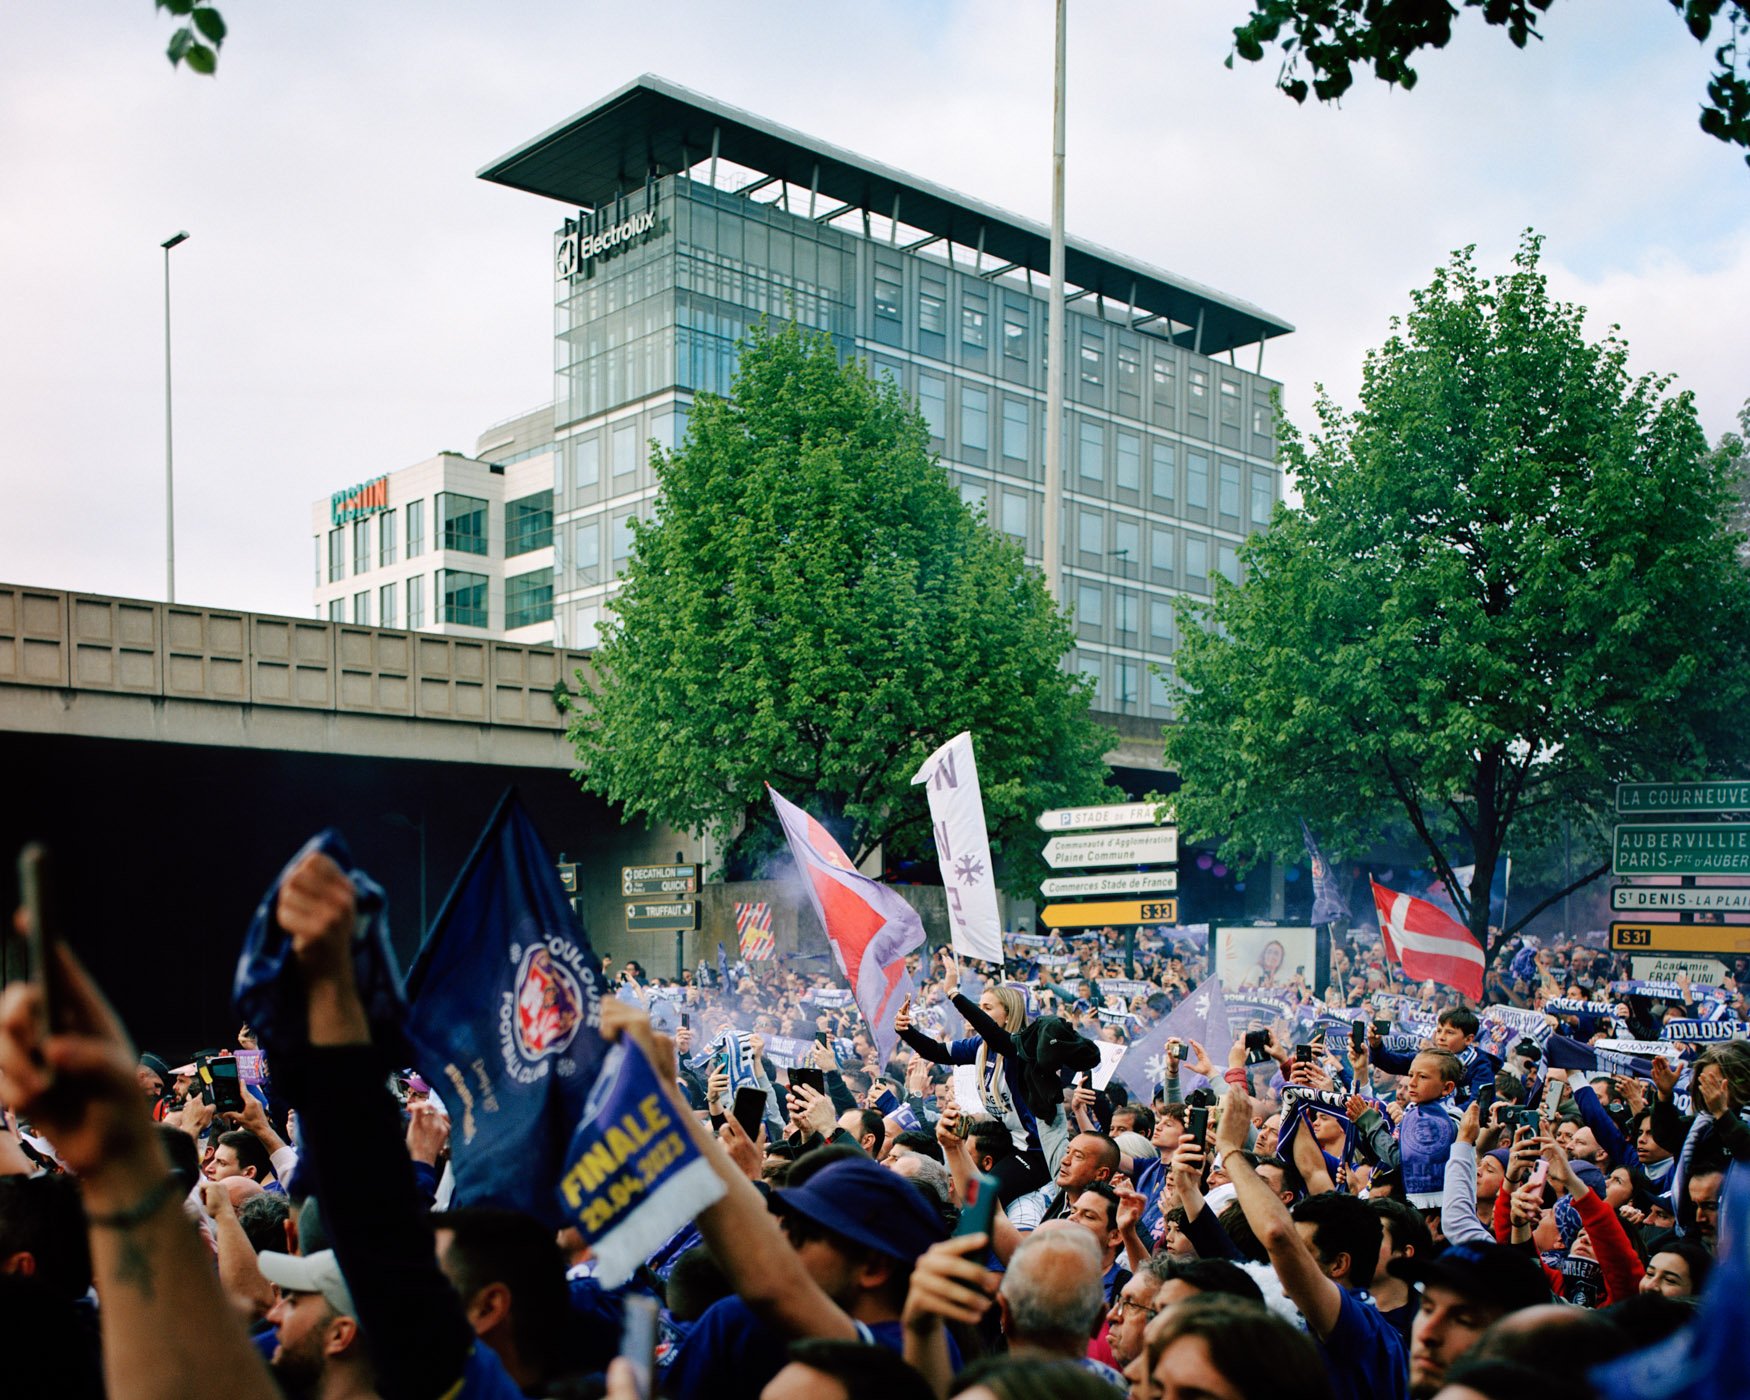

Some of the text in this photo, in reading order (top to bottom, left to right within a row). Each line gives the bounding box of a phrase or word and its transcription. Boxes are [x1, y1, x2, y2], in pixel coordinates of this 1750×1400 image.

[580, 211, 656, 260] Electrolux
[1622, 787, 1749, 806] LA COURNEUVE
[1074, 812, 1109, 825] STADE
[1129, 807, 1151, 820] FRA
[1055, 834, 1174, 850] Communauté d'Agglomération
[1620, 832, 1748, 848] AUBERVILLIE
[1054, 850, 1136, 863] Plaine Commune
[633, 867, 677, 880] DECATHLON
[661, 880, 687, 892] QUICK
[1048, 876, 1174, 893] Commerces Stade de France
[1716, 895, 1750, 906] PLAI
[645, 904, 683, 917] TRUFFAUT
[545, 933, 600, 1028] OULOUSE
[1648, 971, 1714, 984] FRATLINI
[1635, 986, 1705, 1002] FOOTBALL CUB
[1665, 1021, 1742, 1040] TOULOUSE
[561, 1094, 672, 1209] FINALE
